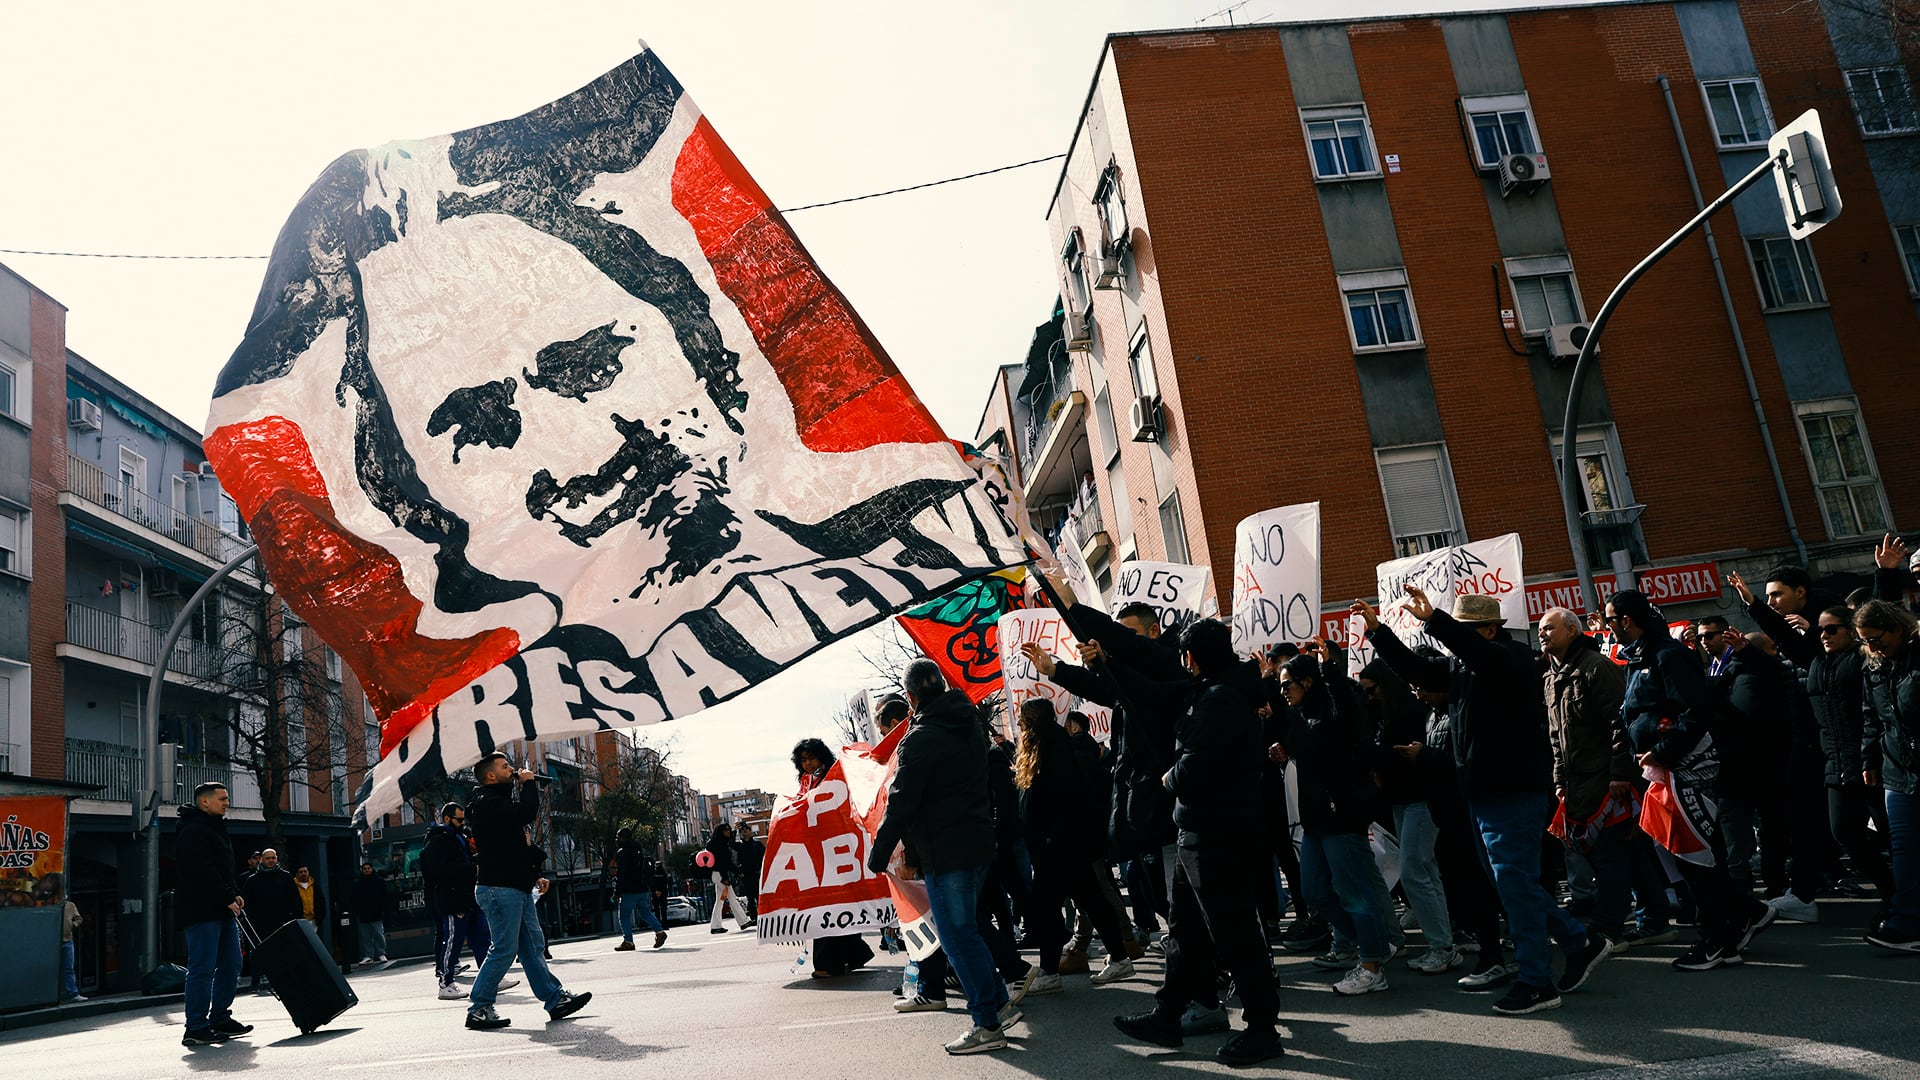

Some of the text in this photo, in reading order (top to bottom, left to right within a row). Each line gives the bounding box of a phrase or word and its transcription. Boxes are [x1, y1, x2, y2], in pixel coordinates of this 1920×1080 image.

[1248, 524, 1285, 566] NO
[1452, 547, 1488, 578] RA
[1117, 567, 1142, 597] NO
[1147, 571, 1184, 603] ES
[1526, 569, 1717, 616] HAMBRESERIA
[1008, 617, 1080, 661] QUIER
[363, 621, 753, 826] PRESA
[1087, 711, 1110, 737] DIO
[0, 815, 50, 852] ÑAS
[1682, 787, 1704, 820] ESTE
[1700, 819, 1714, 837] ES
[762, 825, 878, 895] AB
